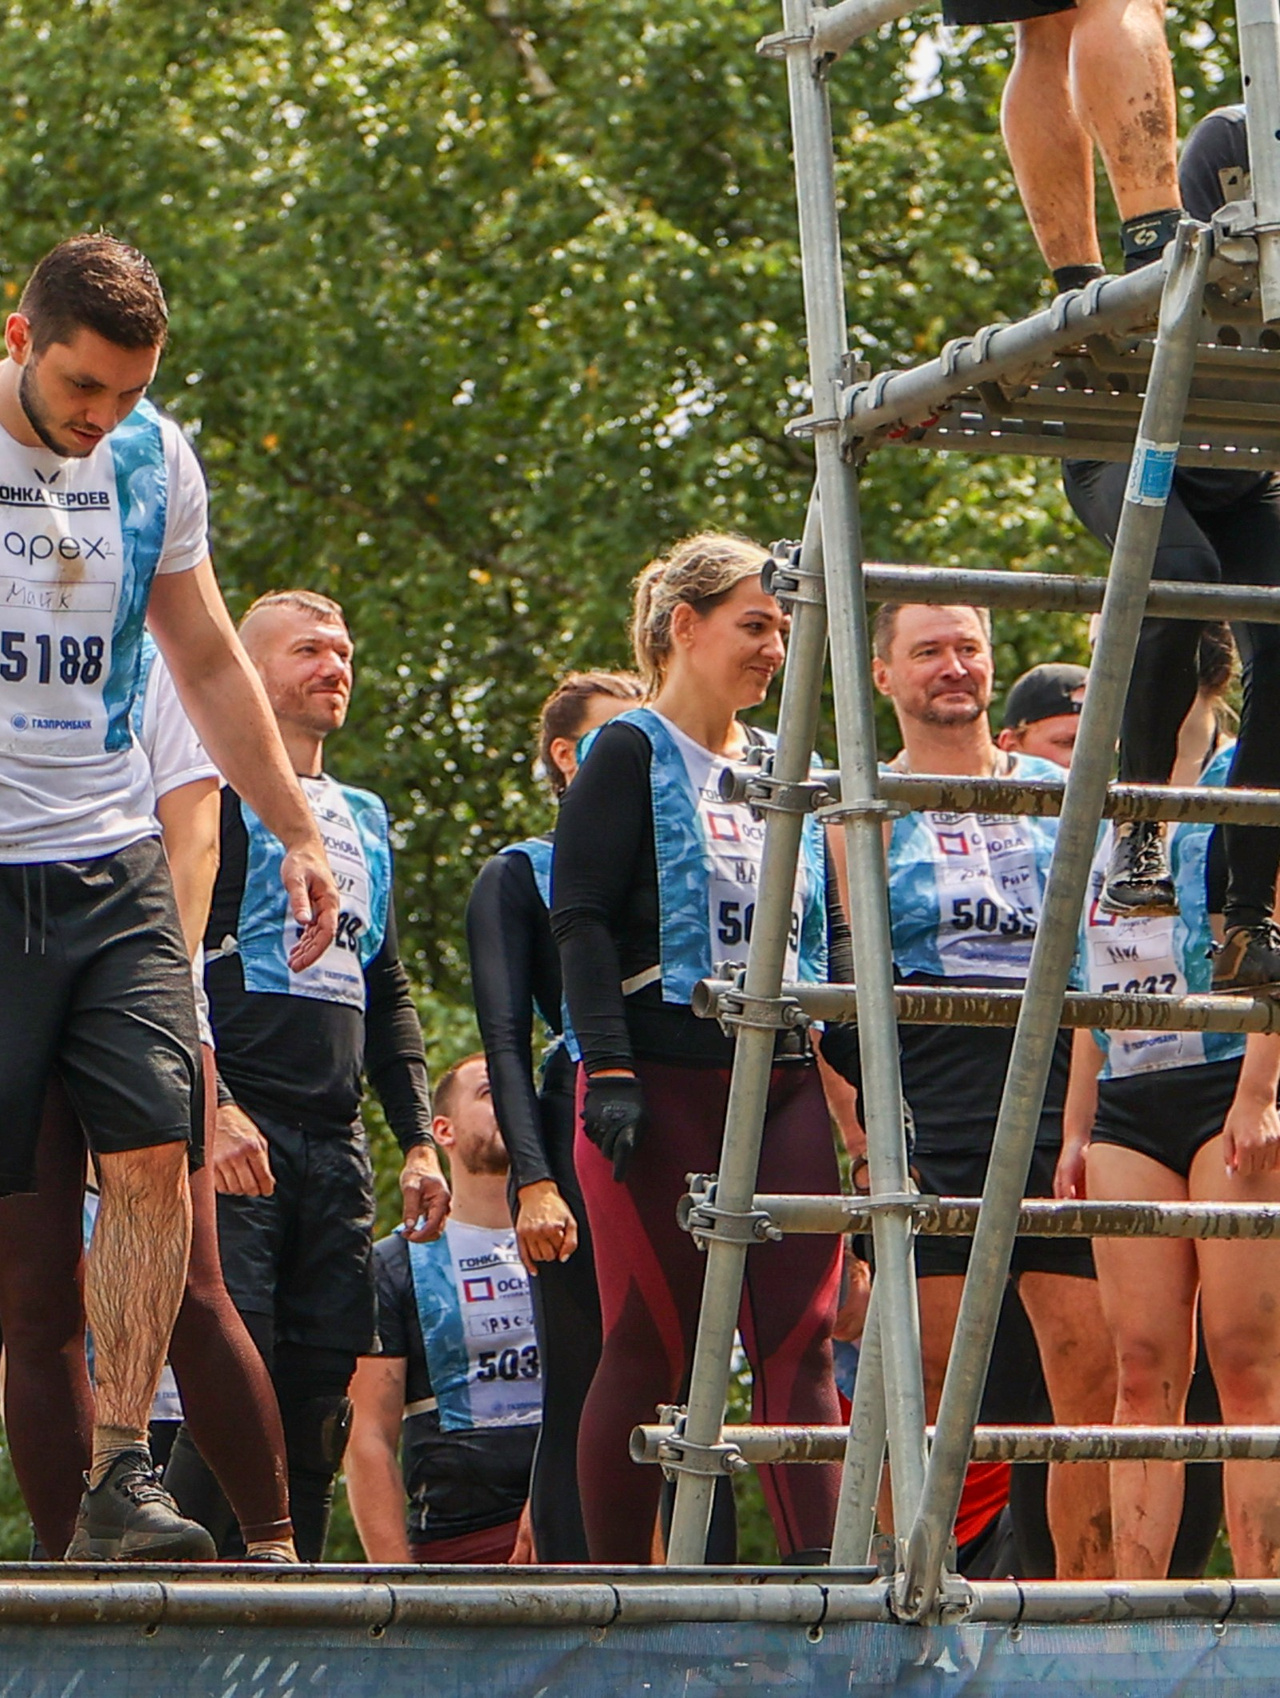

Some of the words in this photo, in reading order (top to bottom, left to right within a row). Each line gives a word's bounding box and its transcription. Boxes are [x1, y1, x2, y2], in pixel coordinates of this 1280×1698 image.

[0, 631, 105, 686] 5188
[31, 717, 92, 731] ГАЗПРОМБАНК
[458, 1253, 501, 1268] ГОНКА
[477, 1345, 540, 1383] 503
